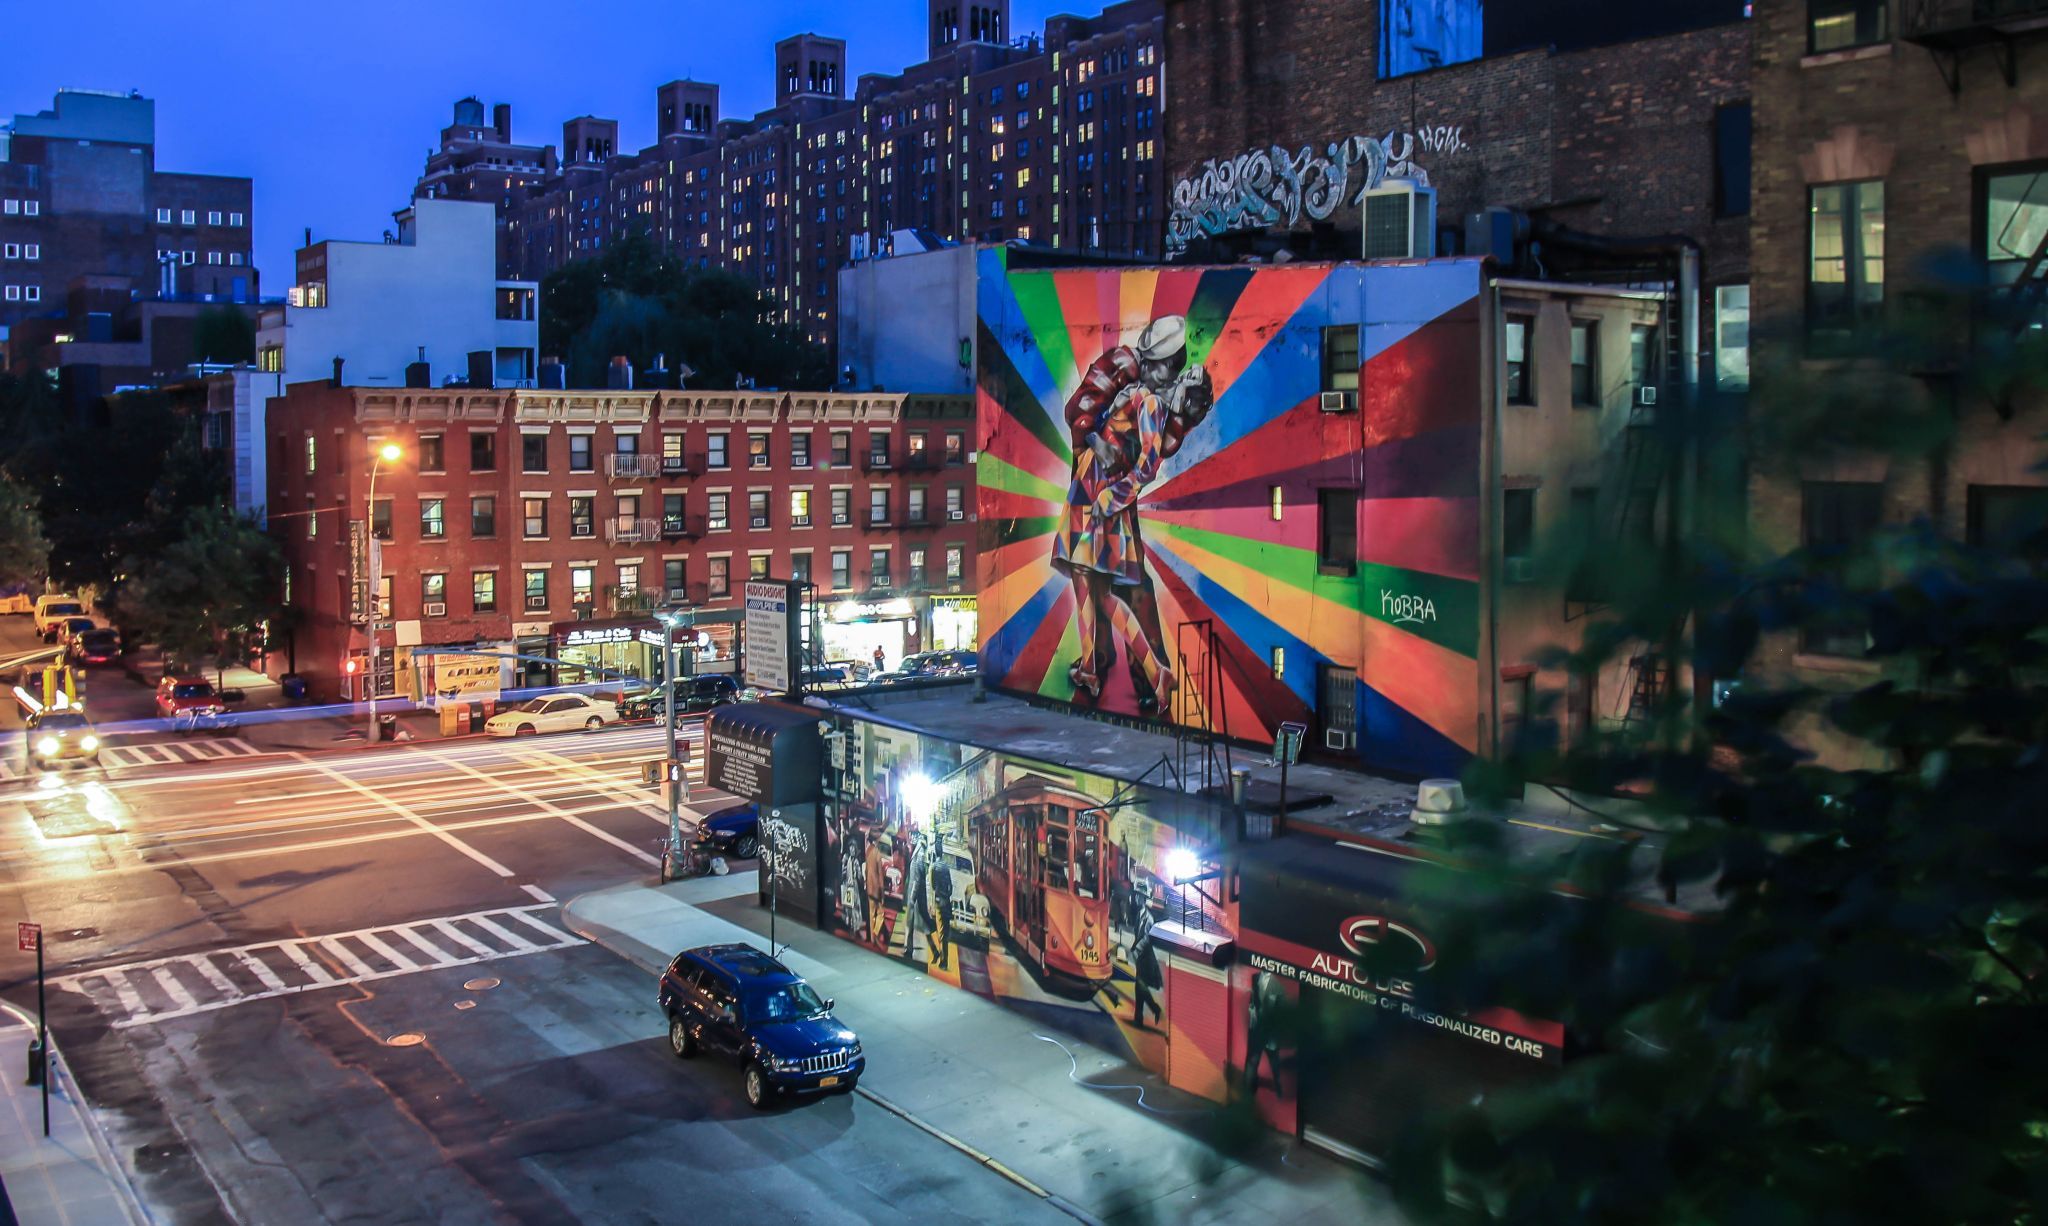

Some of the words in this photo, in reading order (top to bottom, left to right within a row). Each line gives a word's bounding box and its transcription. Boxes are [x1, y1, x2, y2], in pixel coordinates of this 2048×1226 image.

[747, 584, 763, 596] AUDIO
[763, 586, 785, 599] DESIGNS
[1381, 589, 1436, 621] KOBRA
[1311, 953, 1369, 985] AUTO
[1251, 954, 1296, 978] MASTER
[1299, 970, 1377, 1005] FABRICATORS
[1505, 1035, 1543, 1059] CARS
